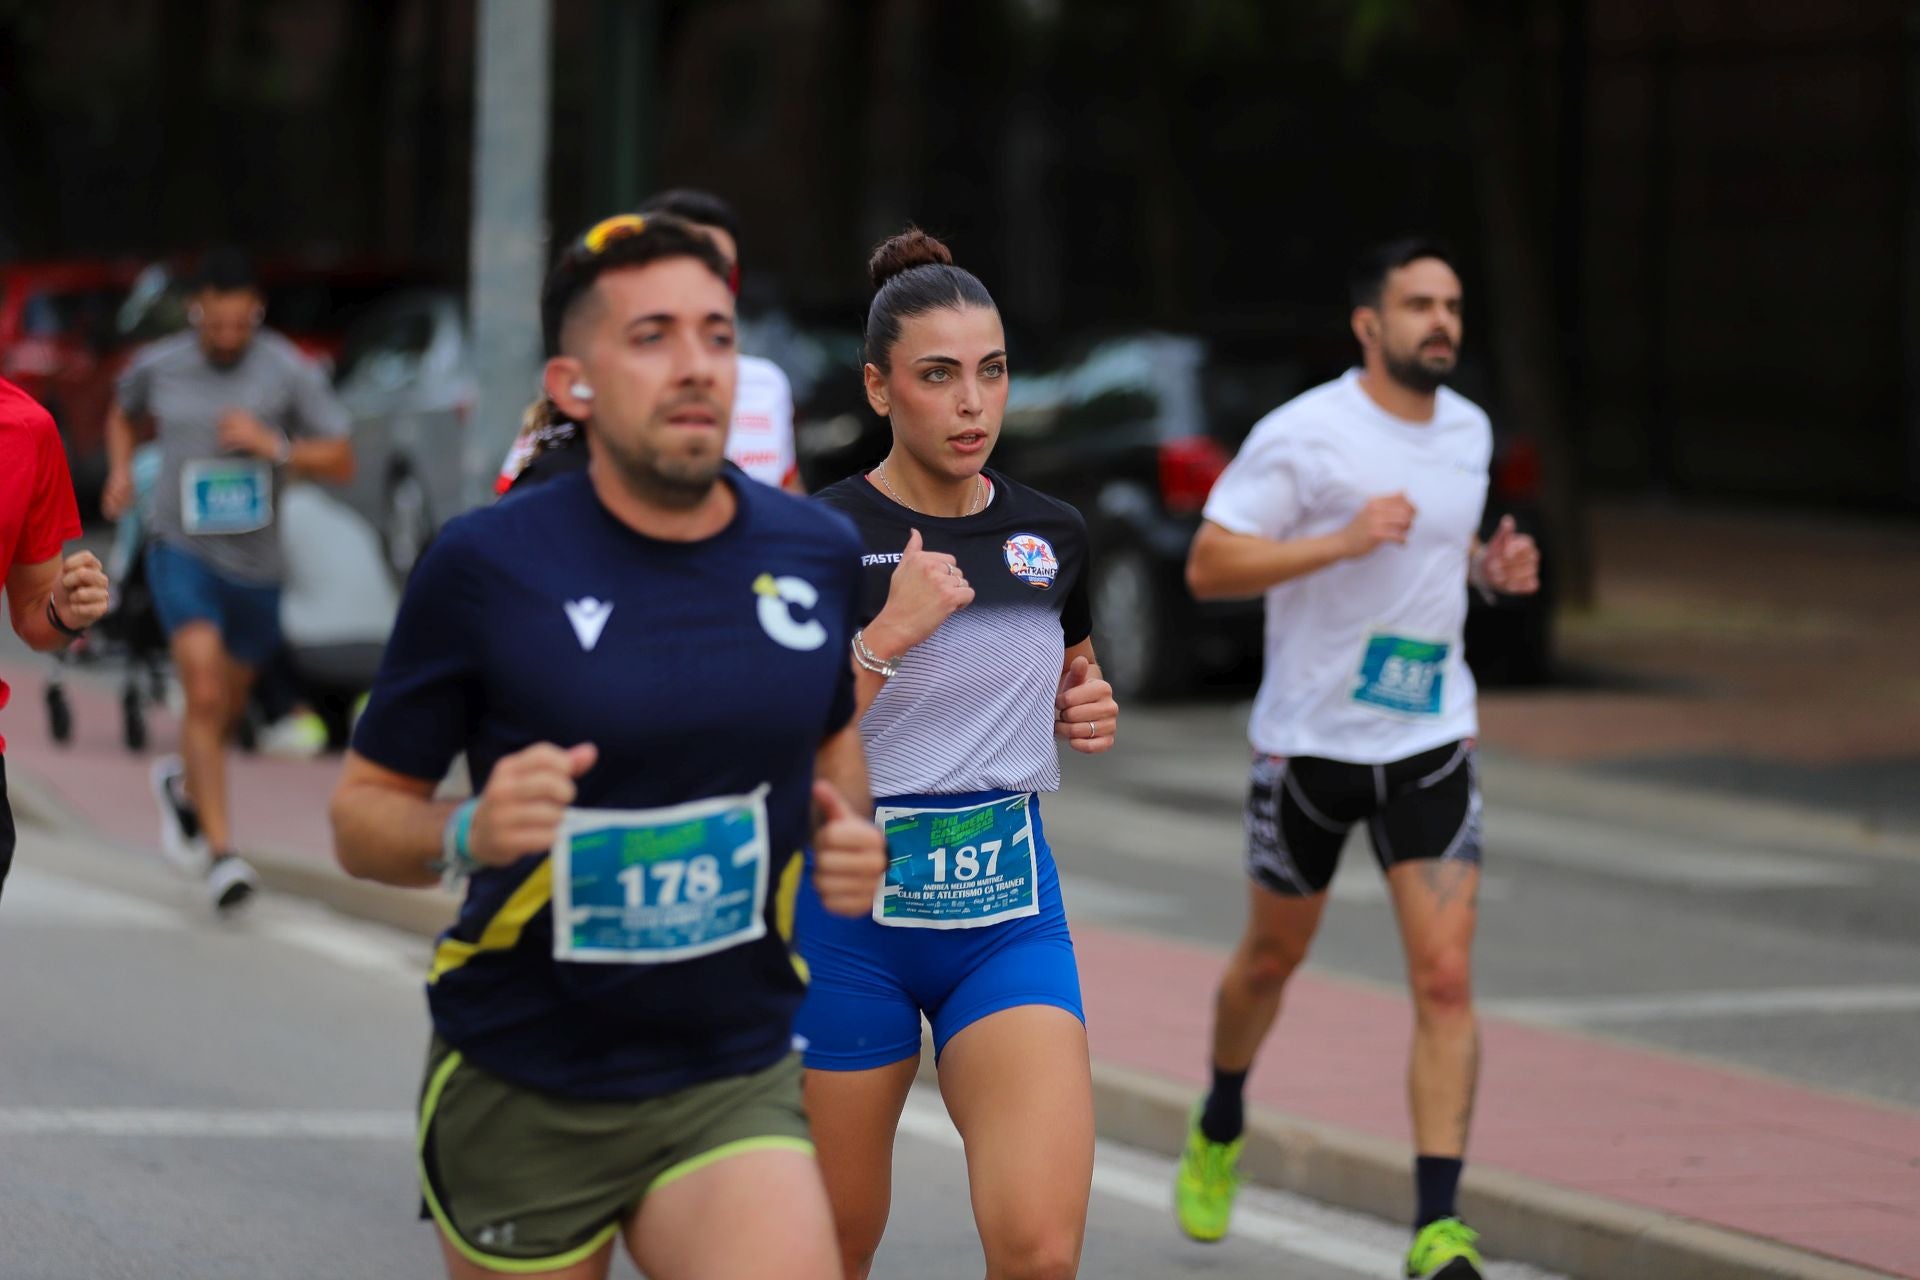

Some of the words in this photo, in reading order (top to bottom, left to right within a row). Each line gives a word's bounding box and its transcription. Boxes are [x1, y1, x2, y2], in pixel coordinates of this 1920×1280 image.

[861, 553, 903, 567] FASTE
[928, 839, 1002, 882] 187
[617, 854, 722, 907] 178
[898, 890, 921, 900] CLUB
[923, 891, 936, 900] DE
[937, 887, 982, 899] ATLETISMO
[984, 885, 994, 894] CA
[996, 877, 1025, 892] TRAINER
[923, 883, 949, 891] ANDREA
[950, 880, 976, 890] MELERO
[976, 874, 1004, 887] MARTINEZ
